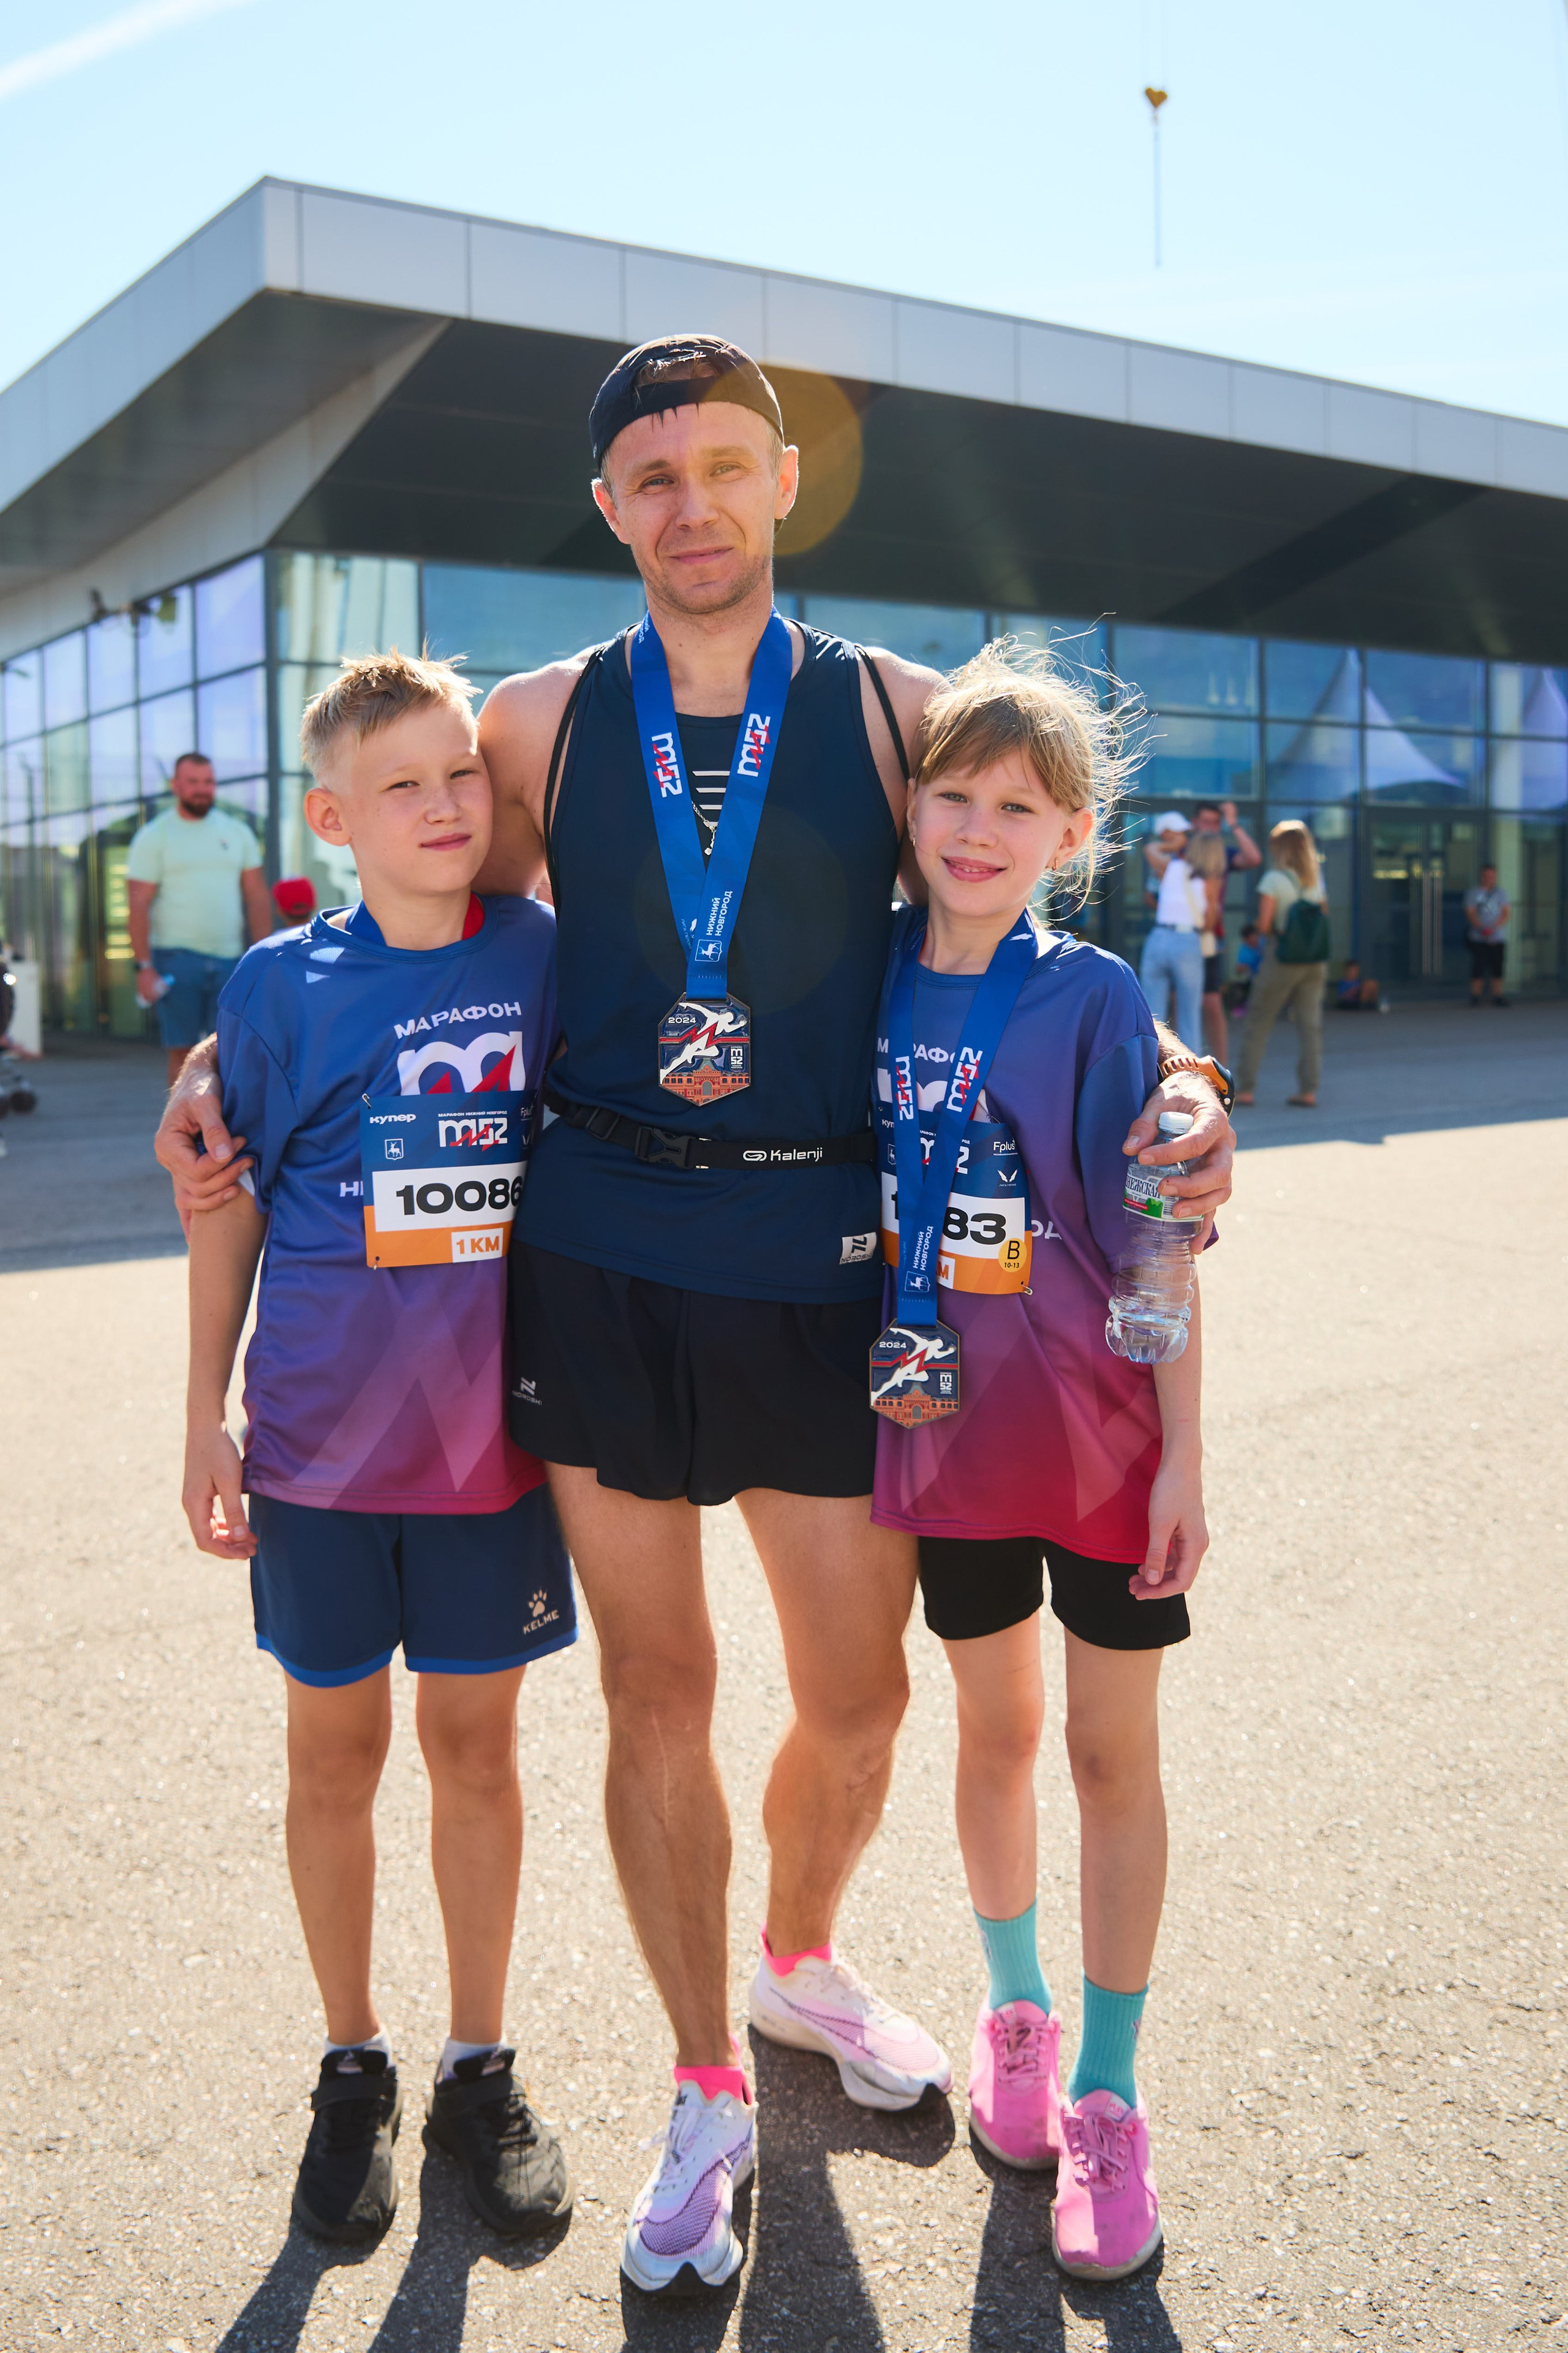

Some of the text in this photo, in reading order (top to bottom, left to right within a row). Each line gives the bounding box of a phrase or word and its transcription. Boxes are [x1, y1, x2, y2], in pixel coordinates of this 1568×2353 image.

[706, 897, 721, 936] НИЖНИЙ
[714, 891, 733, 937] НОВГОРОД
[394, 1001, 522, 1040] МАРАФОН
[369, 1113, 417, 1125] купер
[770, 1146, 823, 1162] Kalenji
[993, 1141, 1016, 1153] Fplus
[396, 1175, 523, 1216] 10086
[455, 1237, 466, 1255] 1
[913, 1231, 924, 1269] НИЖНИЙ
[919, 1225, 934, 1271] НОВГОРОД
[522, 1609, 560, 1635] KELME
